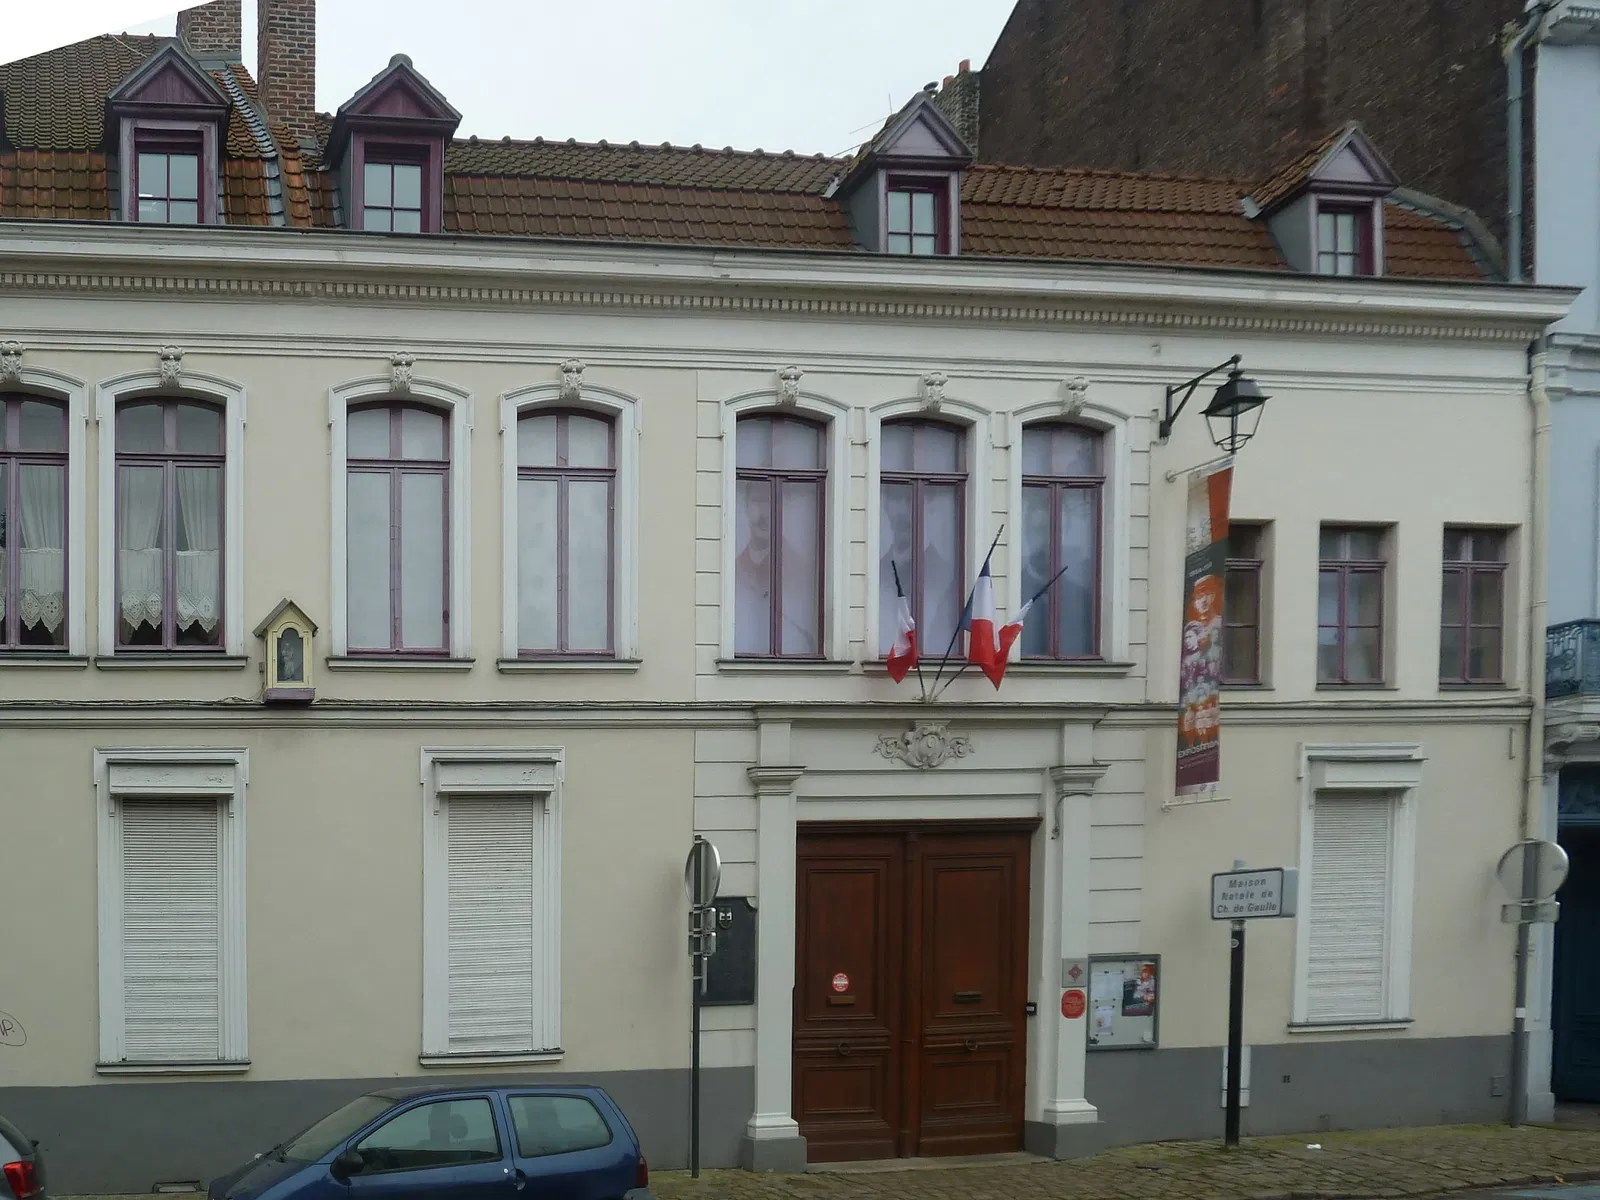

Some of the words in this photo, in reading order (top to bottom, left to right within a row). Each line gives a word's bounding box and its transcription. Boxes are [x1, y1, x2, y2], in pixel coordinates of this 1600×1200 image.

[1229, 879, 1266, 888] Maison
[1221, 890, 1255, 900] Natale
[1261, 890, 1273, 898] de
[1233, 903, 1244, 912] de
[1247, 902, 1277, 912] Gaulle
